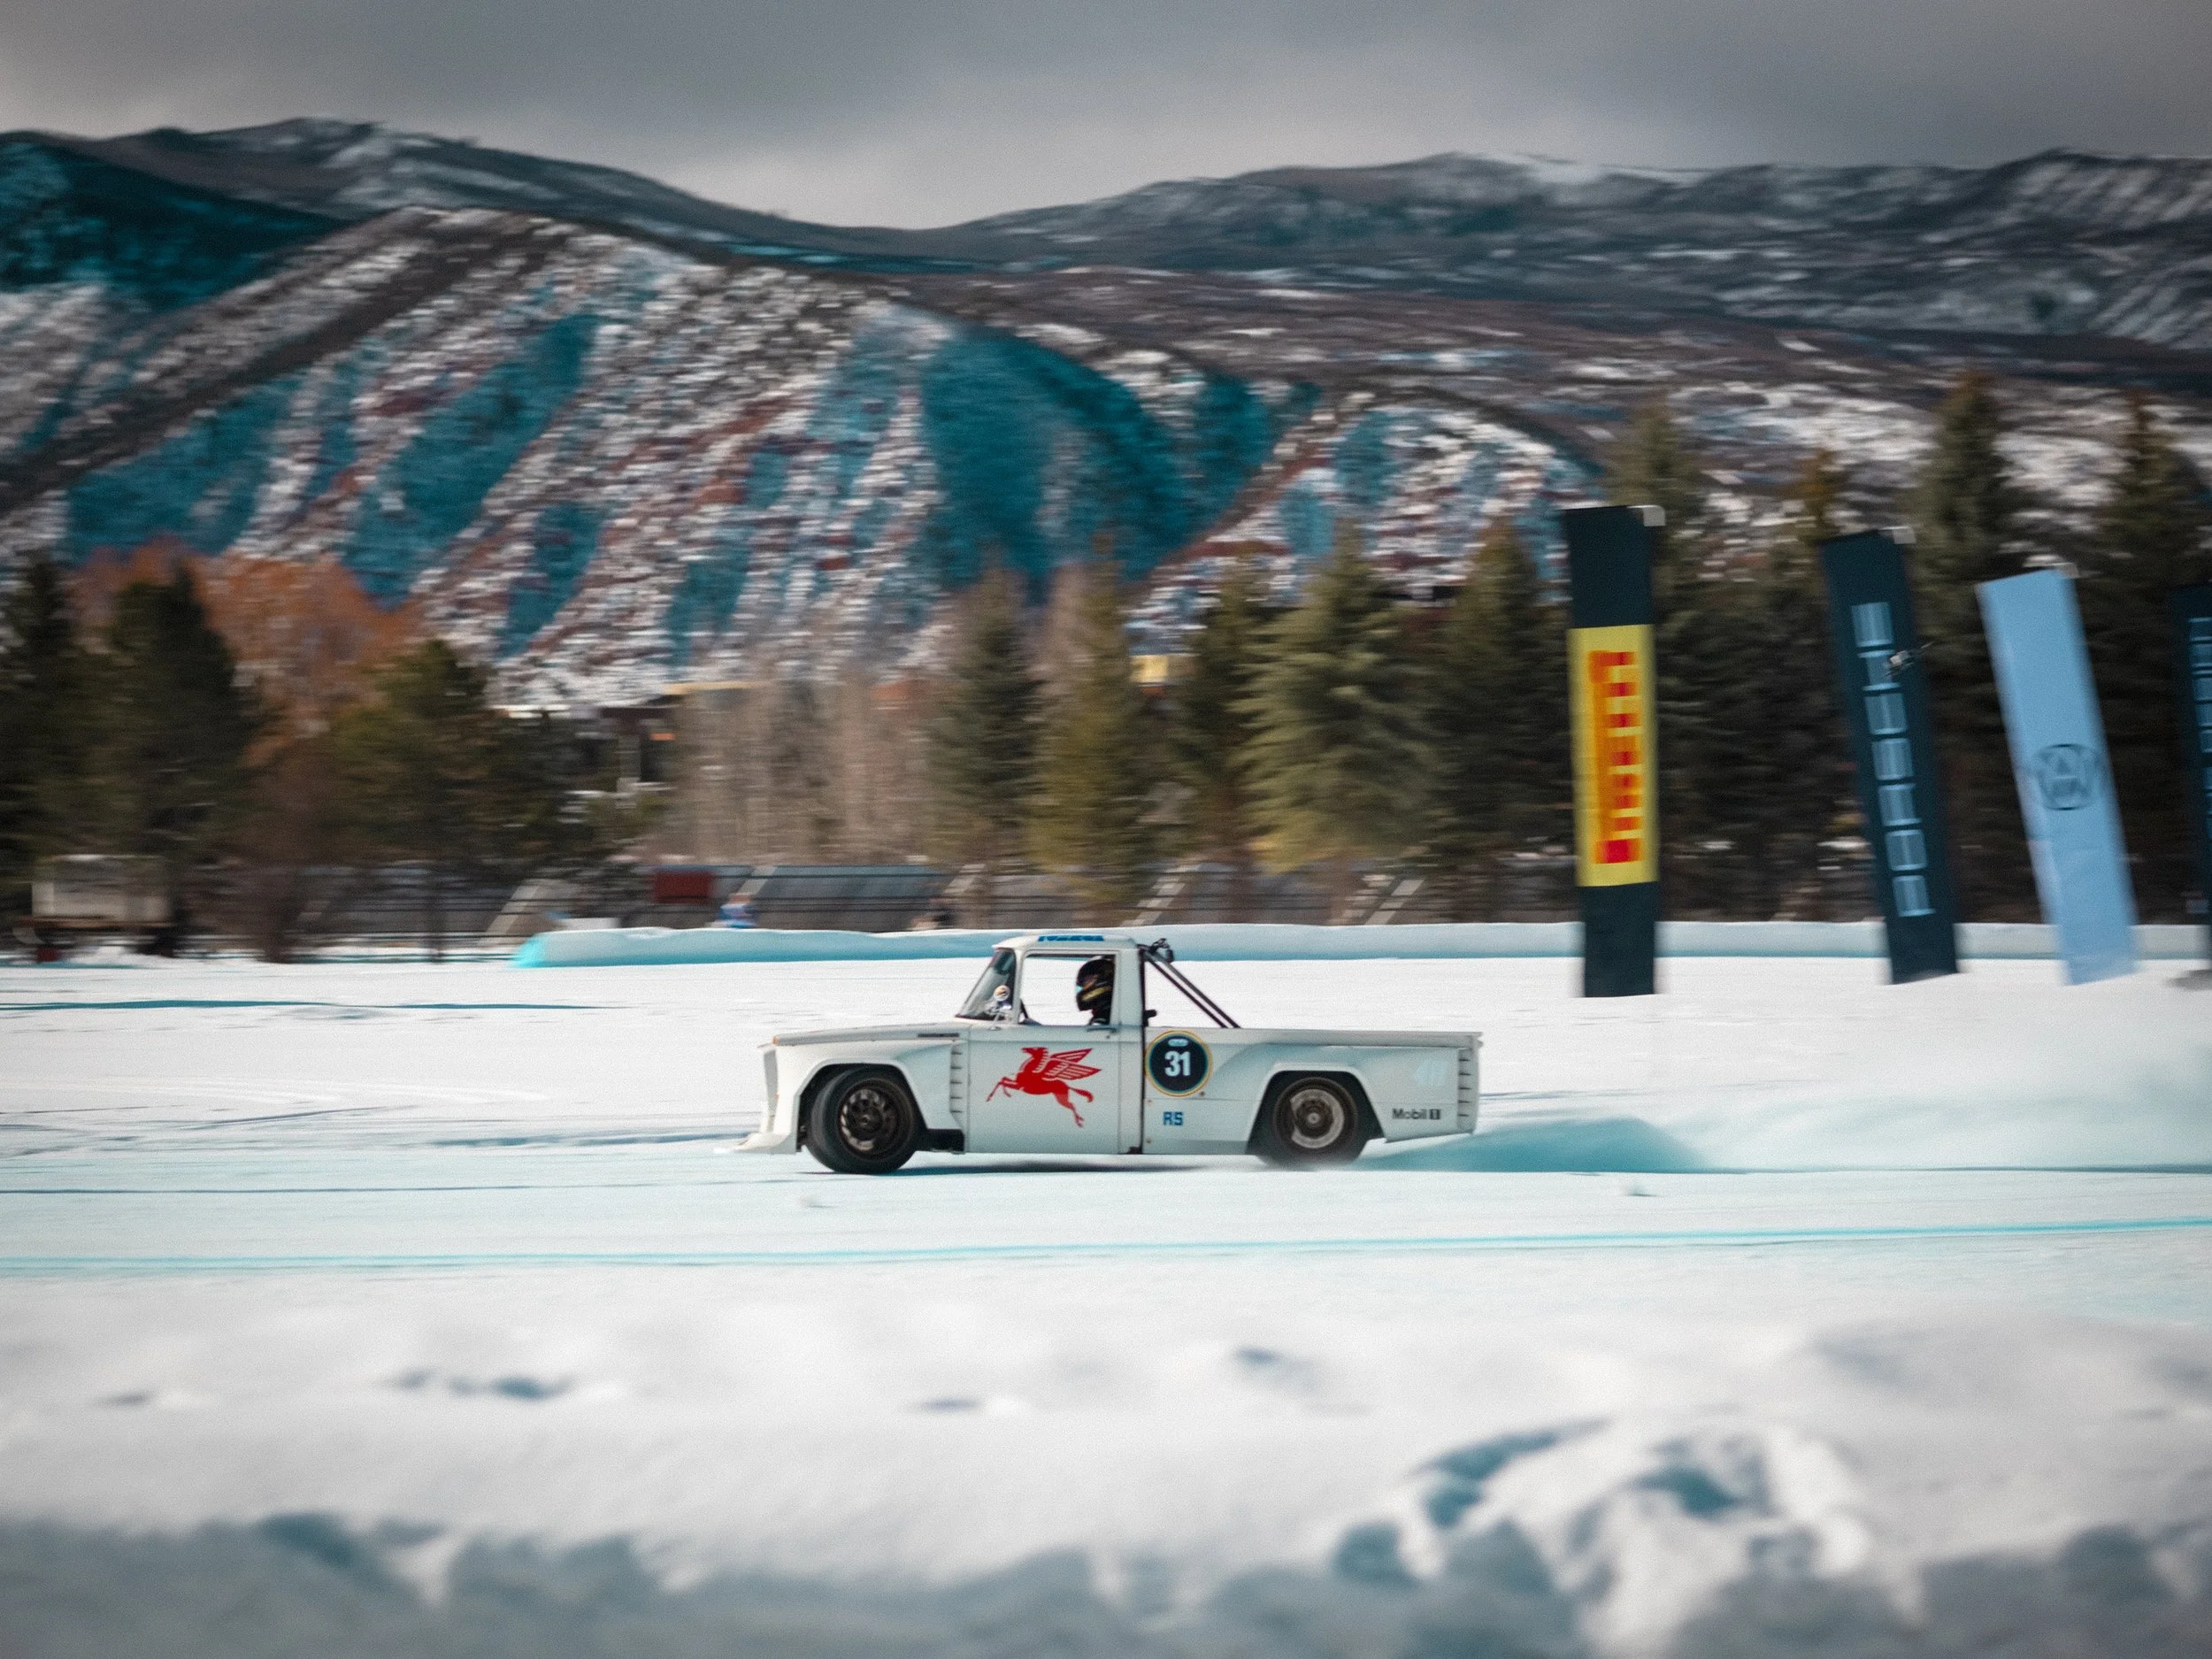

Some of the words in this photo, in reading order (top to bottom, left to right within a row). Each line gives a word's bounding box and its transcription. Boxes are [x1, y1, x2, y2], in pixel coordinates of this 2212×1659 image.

[1164, 1050, 1191, 1077] 31
[1163, 1111, 1183, 1126] RS
[1392, 1108, 1427, 1120] Mobil
